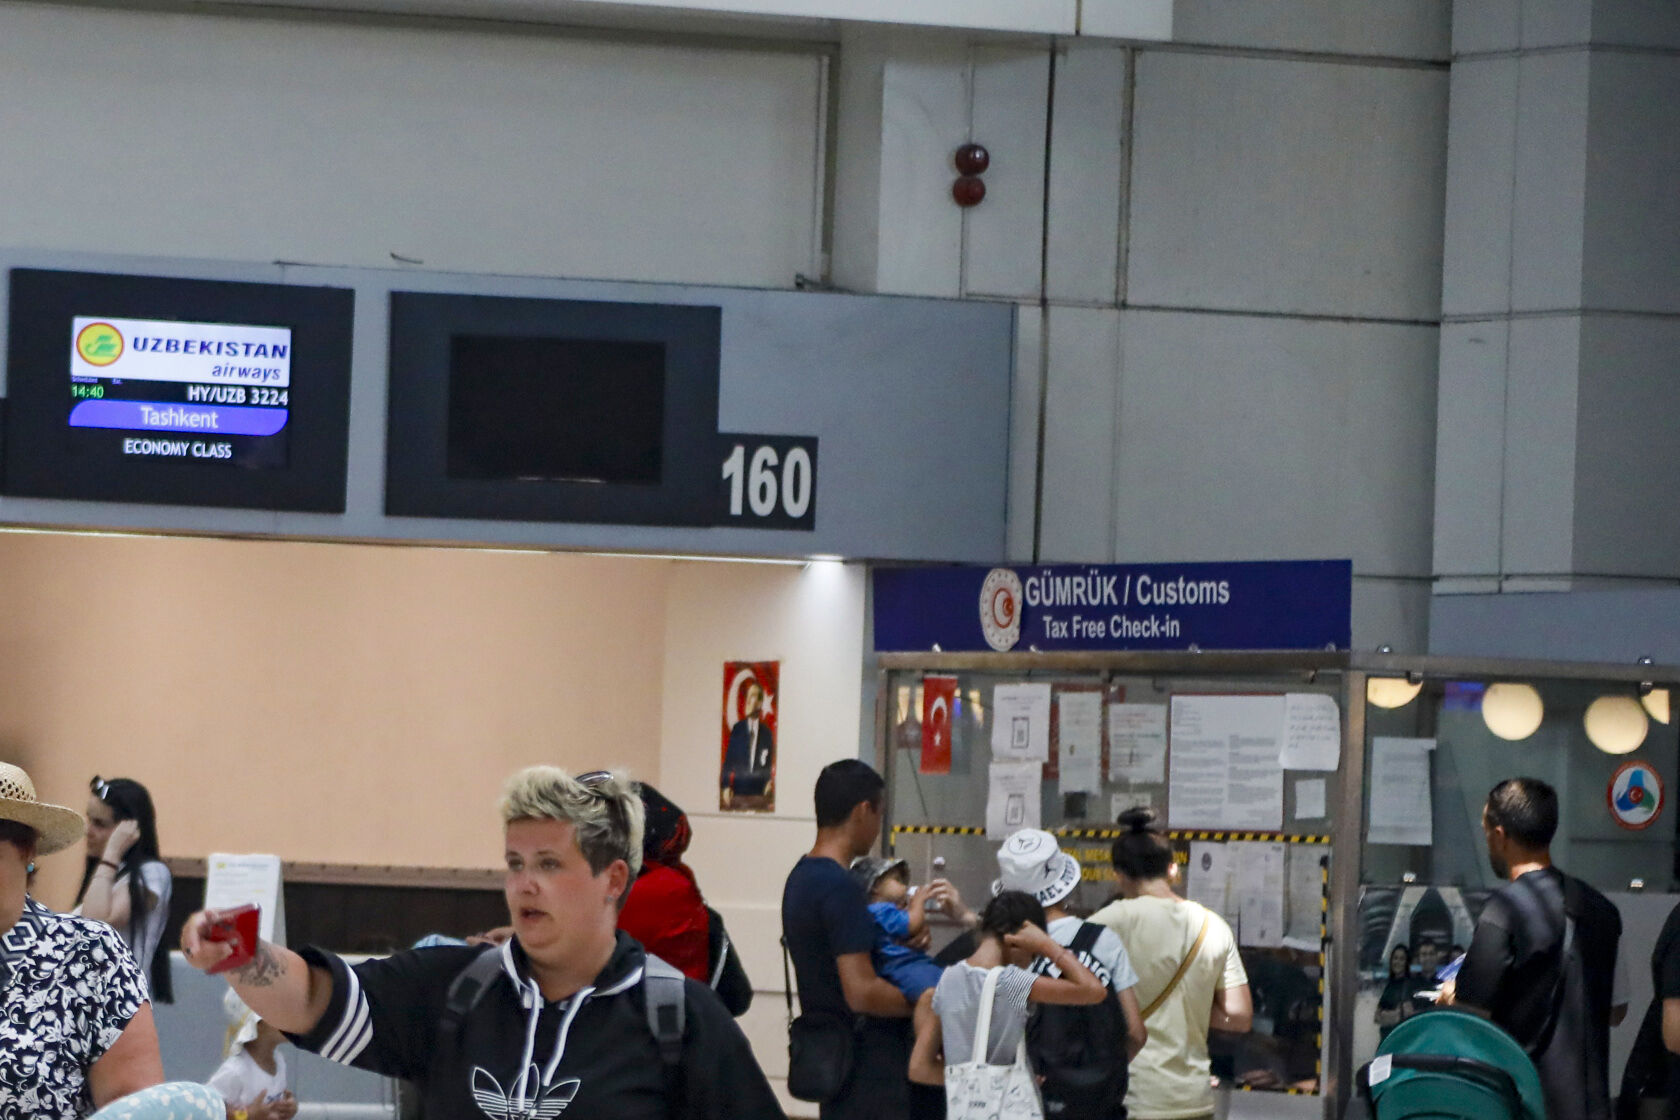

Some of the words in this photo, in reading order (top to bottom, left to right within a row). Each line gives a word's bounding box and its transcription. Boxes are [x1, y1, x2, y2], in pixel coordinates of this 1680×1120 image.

[133, 337, 288, 359] UZBEKISTAN
[212, 363, 281, 382] airways
[72, 384, 104, 399] 14:40
[187, 385, 246, 404] HY/UZB
[250, 387, 289, 406] 3224
[140, 405, 219, 429] Tashkent
[124, 438, 189, 457] ECONOMY
[191, 442, 232, 459] CLASS
[721, 445, 813, 519] 160
[1025, 570, 1119, 607] GÜMRÜK
[1136, 574, 1230, 605] Customs
[1042, 616, 1069, 639] Tax
[1073, 615, 1106, 639] Free
[1110, 614, 1180, 638] Check-in
